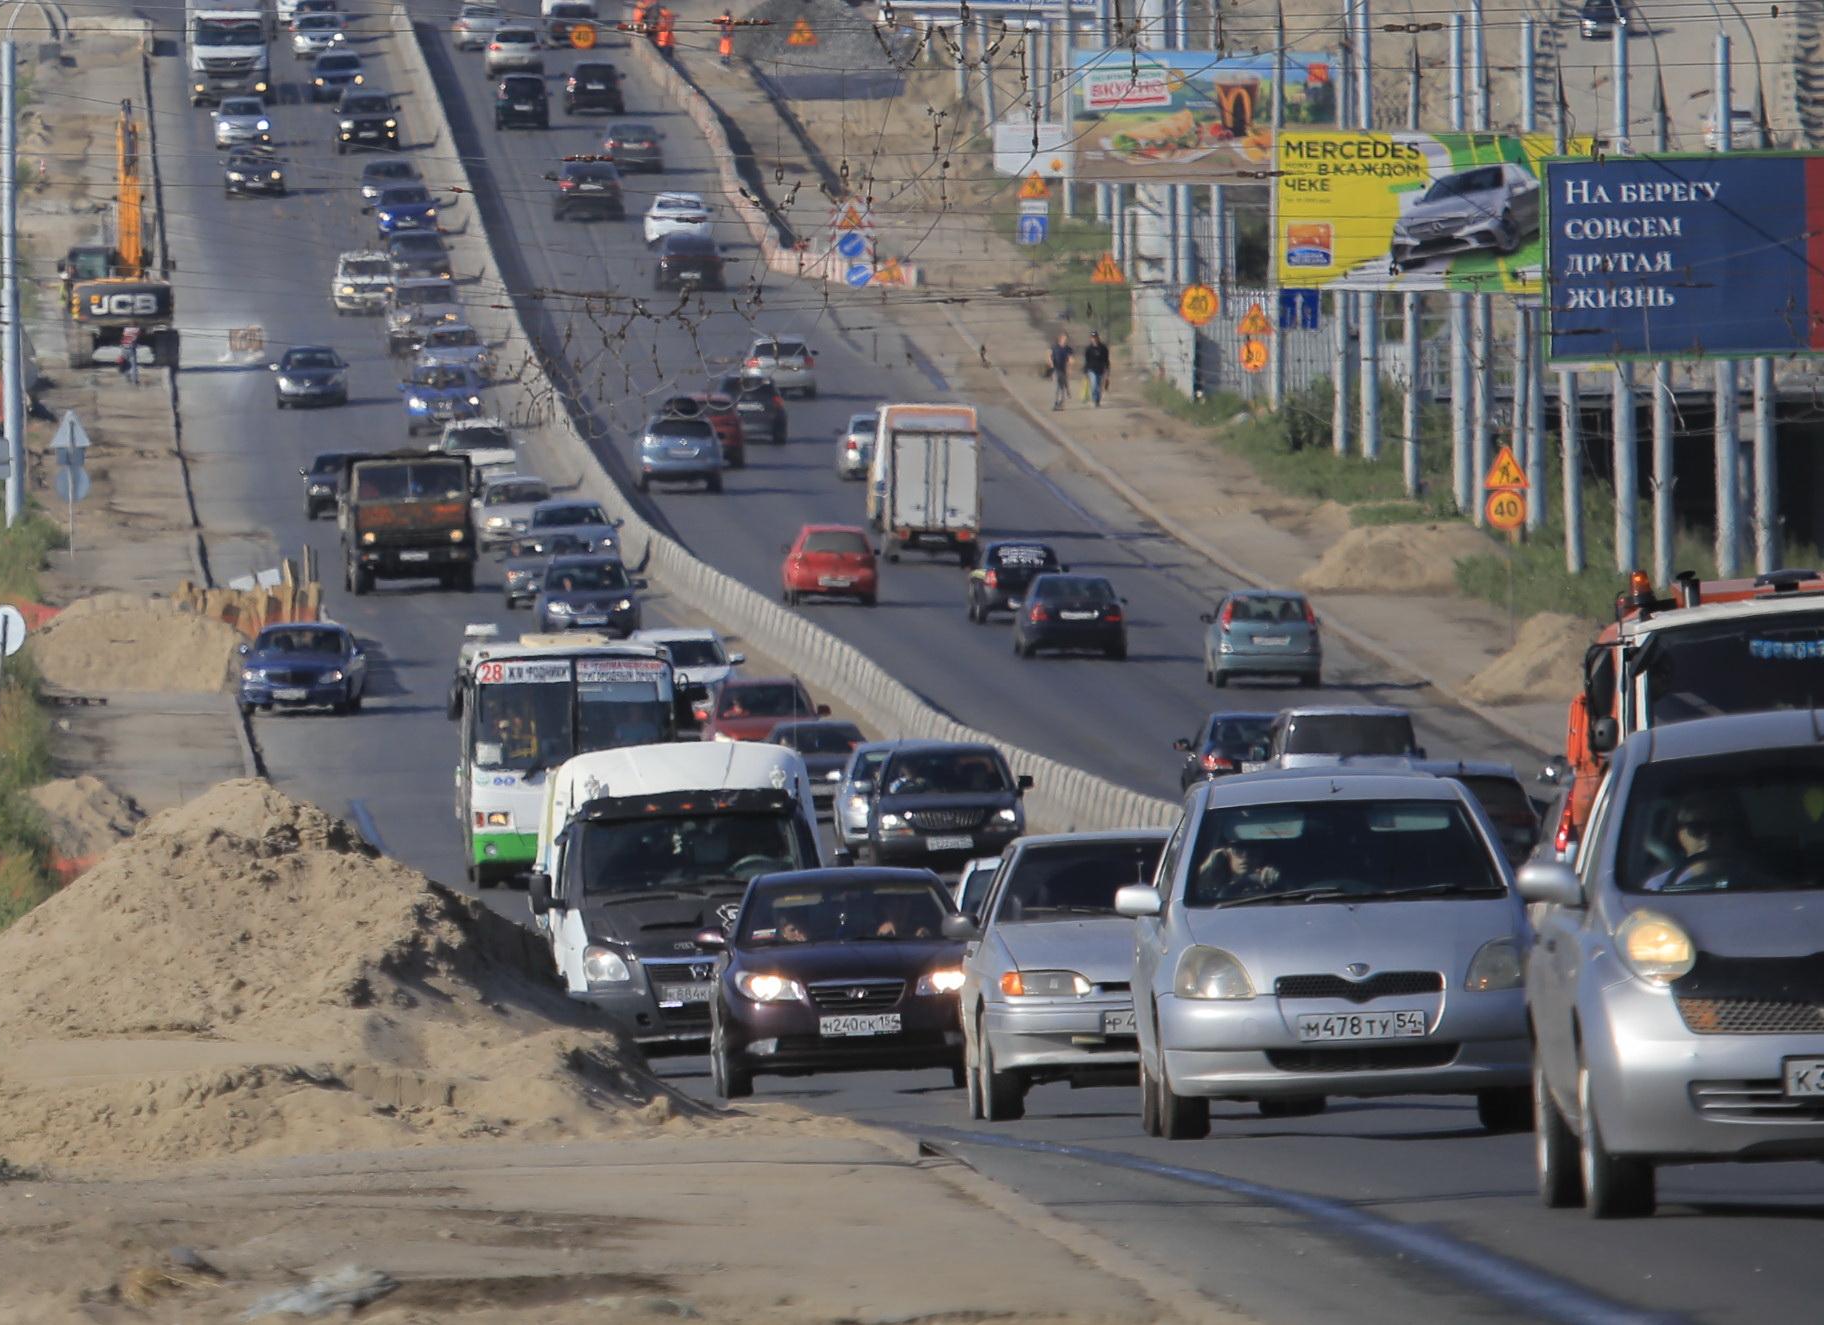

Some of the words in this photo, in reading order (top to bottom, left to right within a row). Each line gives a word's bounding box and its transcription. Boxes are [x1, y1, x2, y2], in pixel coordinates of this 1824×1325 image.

[1286, 141, 1420, 159] MERCEDES
[1333, 162, 1421, 178] КАЖДОМ
[1285, 178, 1330, 192] ЧЕКЕ
[1564, 217, 1681, 240] СОВСЕМ
[1564, 252, 1672, 277] ДРУГАЯ
[90, 294, 157, 315] JCB
[1567, 286, 1676, 309] ЖИЗНЬ
[1494, 501, 1518, 517] 40
[480, 663, 503, 682] 28
[1306, 1016, 1389, 1037] М478ТУ
[1397, 1013, 1418, 1028] 54
